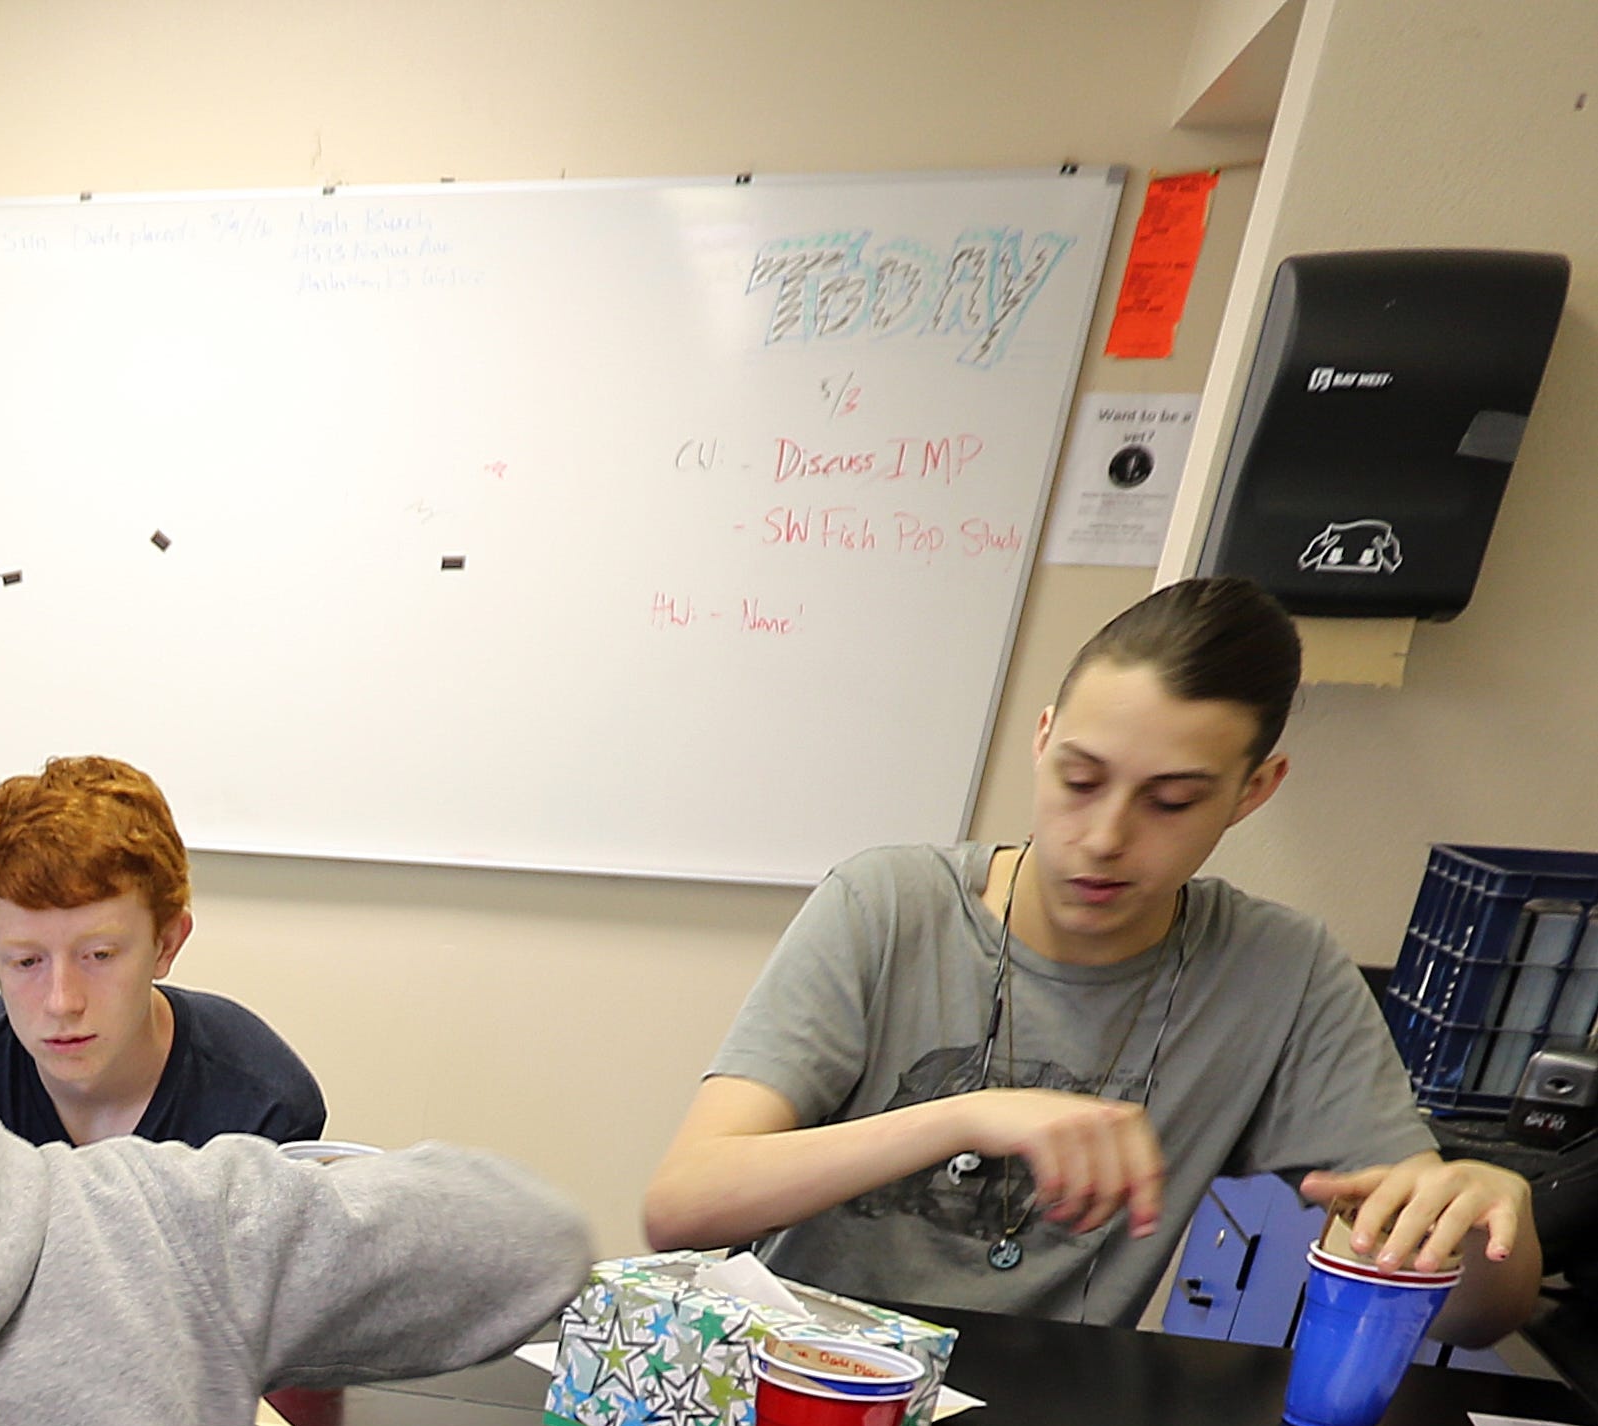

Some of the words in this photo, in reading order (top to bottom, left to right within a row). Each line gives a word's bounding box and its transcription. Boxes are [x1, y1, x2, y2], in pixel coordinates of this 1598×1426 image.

[745, 229, 1077, 371] TODAY
[1099, 407, 1138, 423] Want
[1140, 408, 1158, 423] to
[773, 437, 877, 483] Discuss
[762, 505, 812, 545] SW
[820, 506, 877, 550] Fish
[960, 517, 1023, 563] Study
